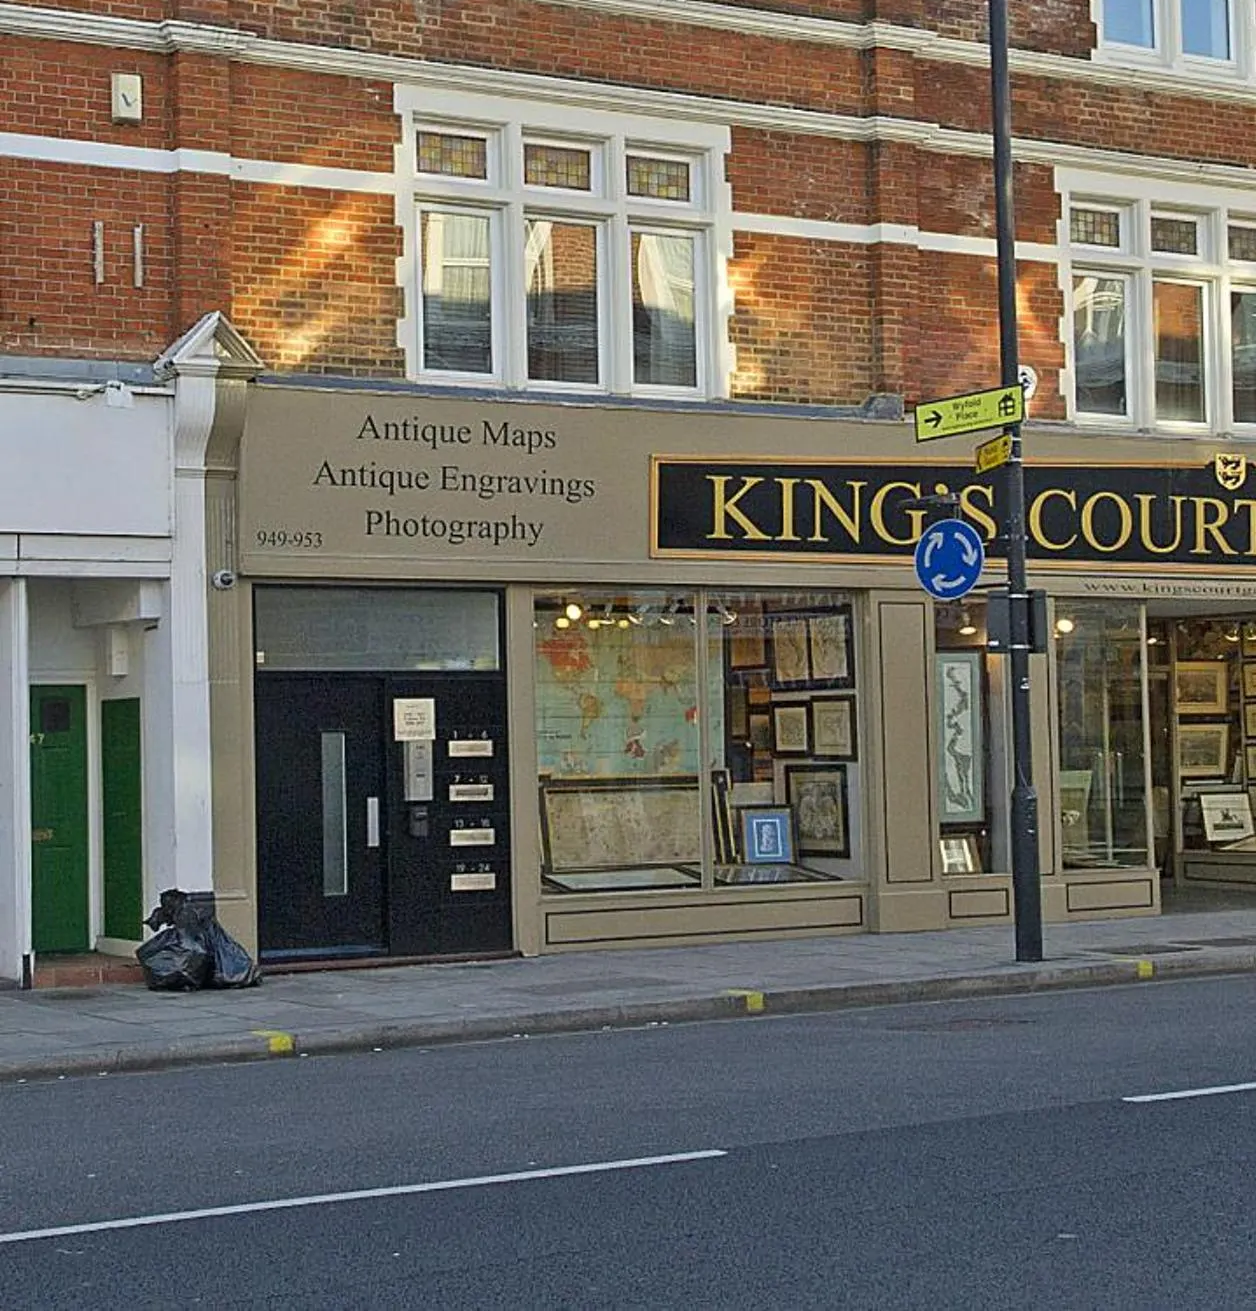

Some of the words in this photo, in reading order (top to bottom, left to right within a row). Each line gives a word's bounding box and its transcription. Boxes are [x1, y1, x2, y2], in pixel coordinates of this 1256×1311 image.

[356, 415, 471, 450] Antique
[482, 420, 556, 454] Maps
[313, 460, 430, 496] Antique
[440, 466, 596, 504] Engravings
[256, 530, 322, 548] 949-953
[365, 510, 544, 546] Photography
